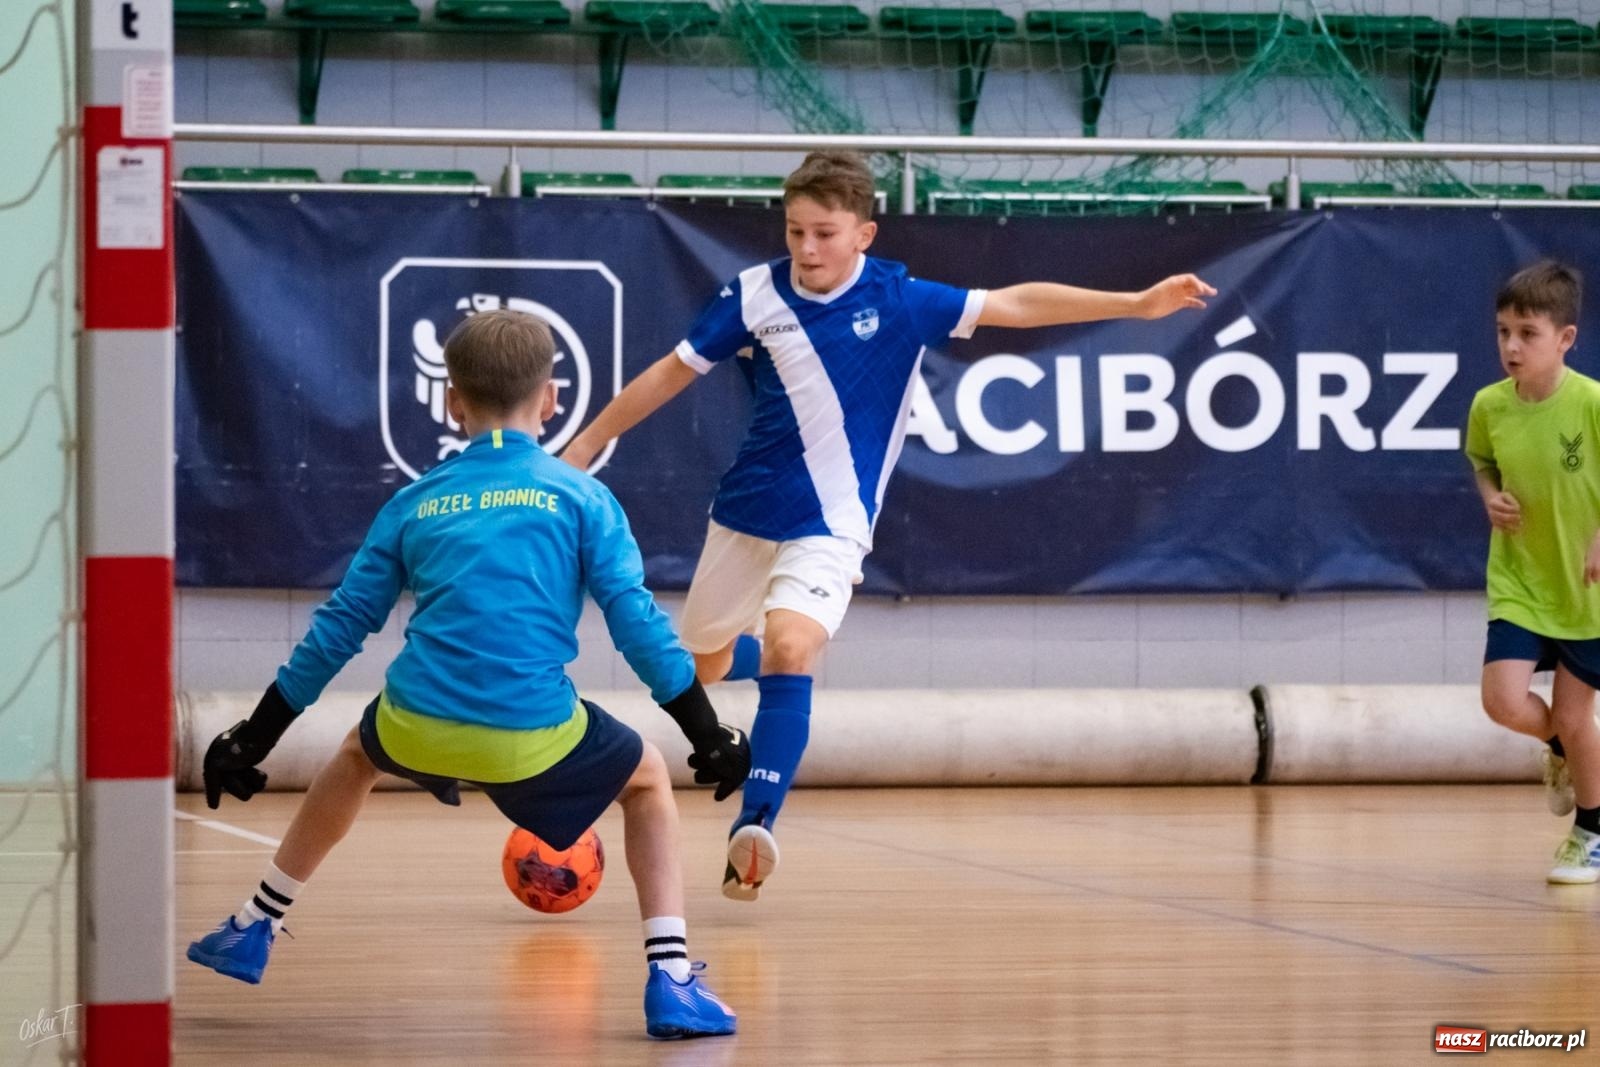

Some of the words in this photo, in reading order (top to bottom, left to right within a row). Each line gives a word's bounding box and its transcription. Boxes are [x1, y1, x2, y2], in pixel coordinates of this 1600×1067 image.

[903, 315, 1461, 454] ACIBÓRZ
[417, 493, 473, 520] ORZEŁ
[480, 488, 559, 513] BRANICE
